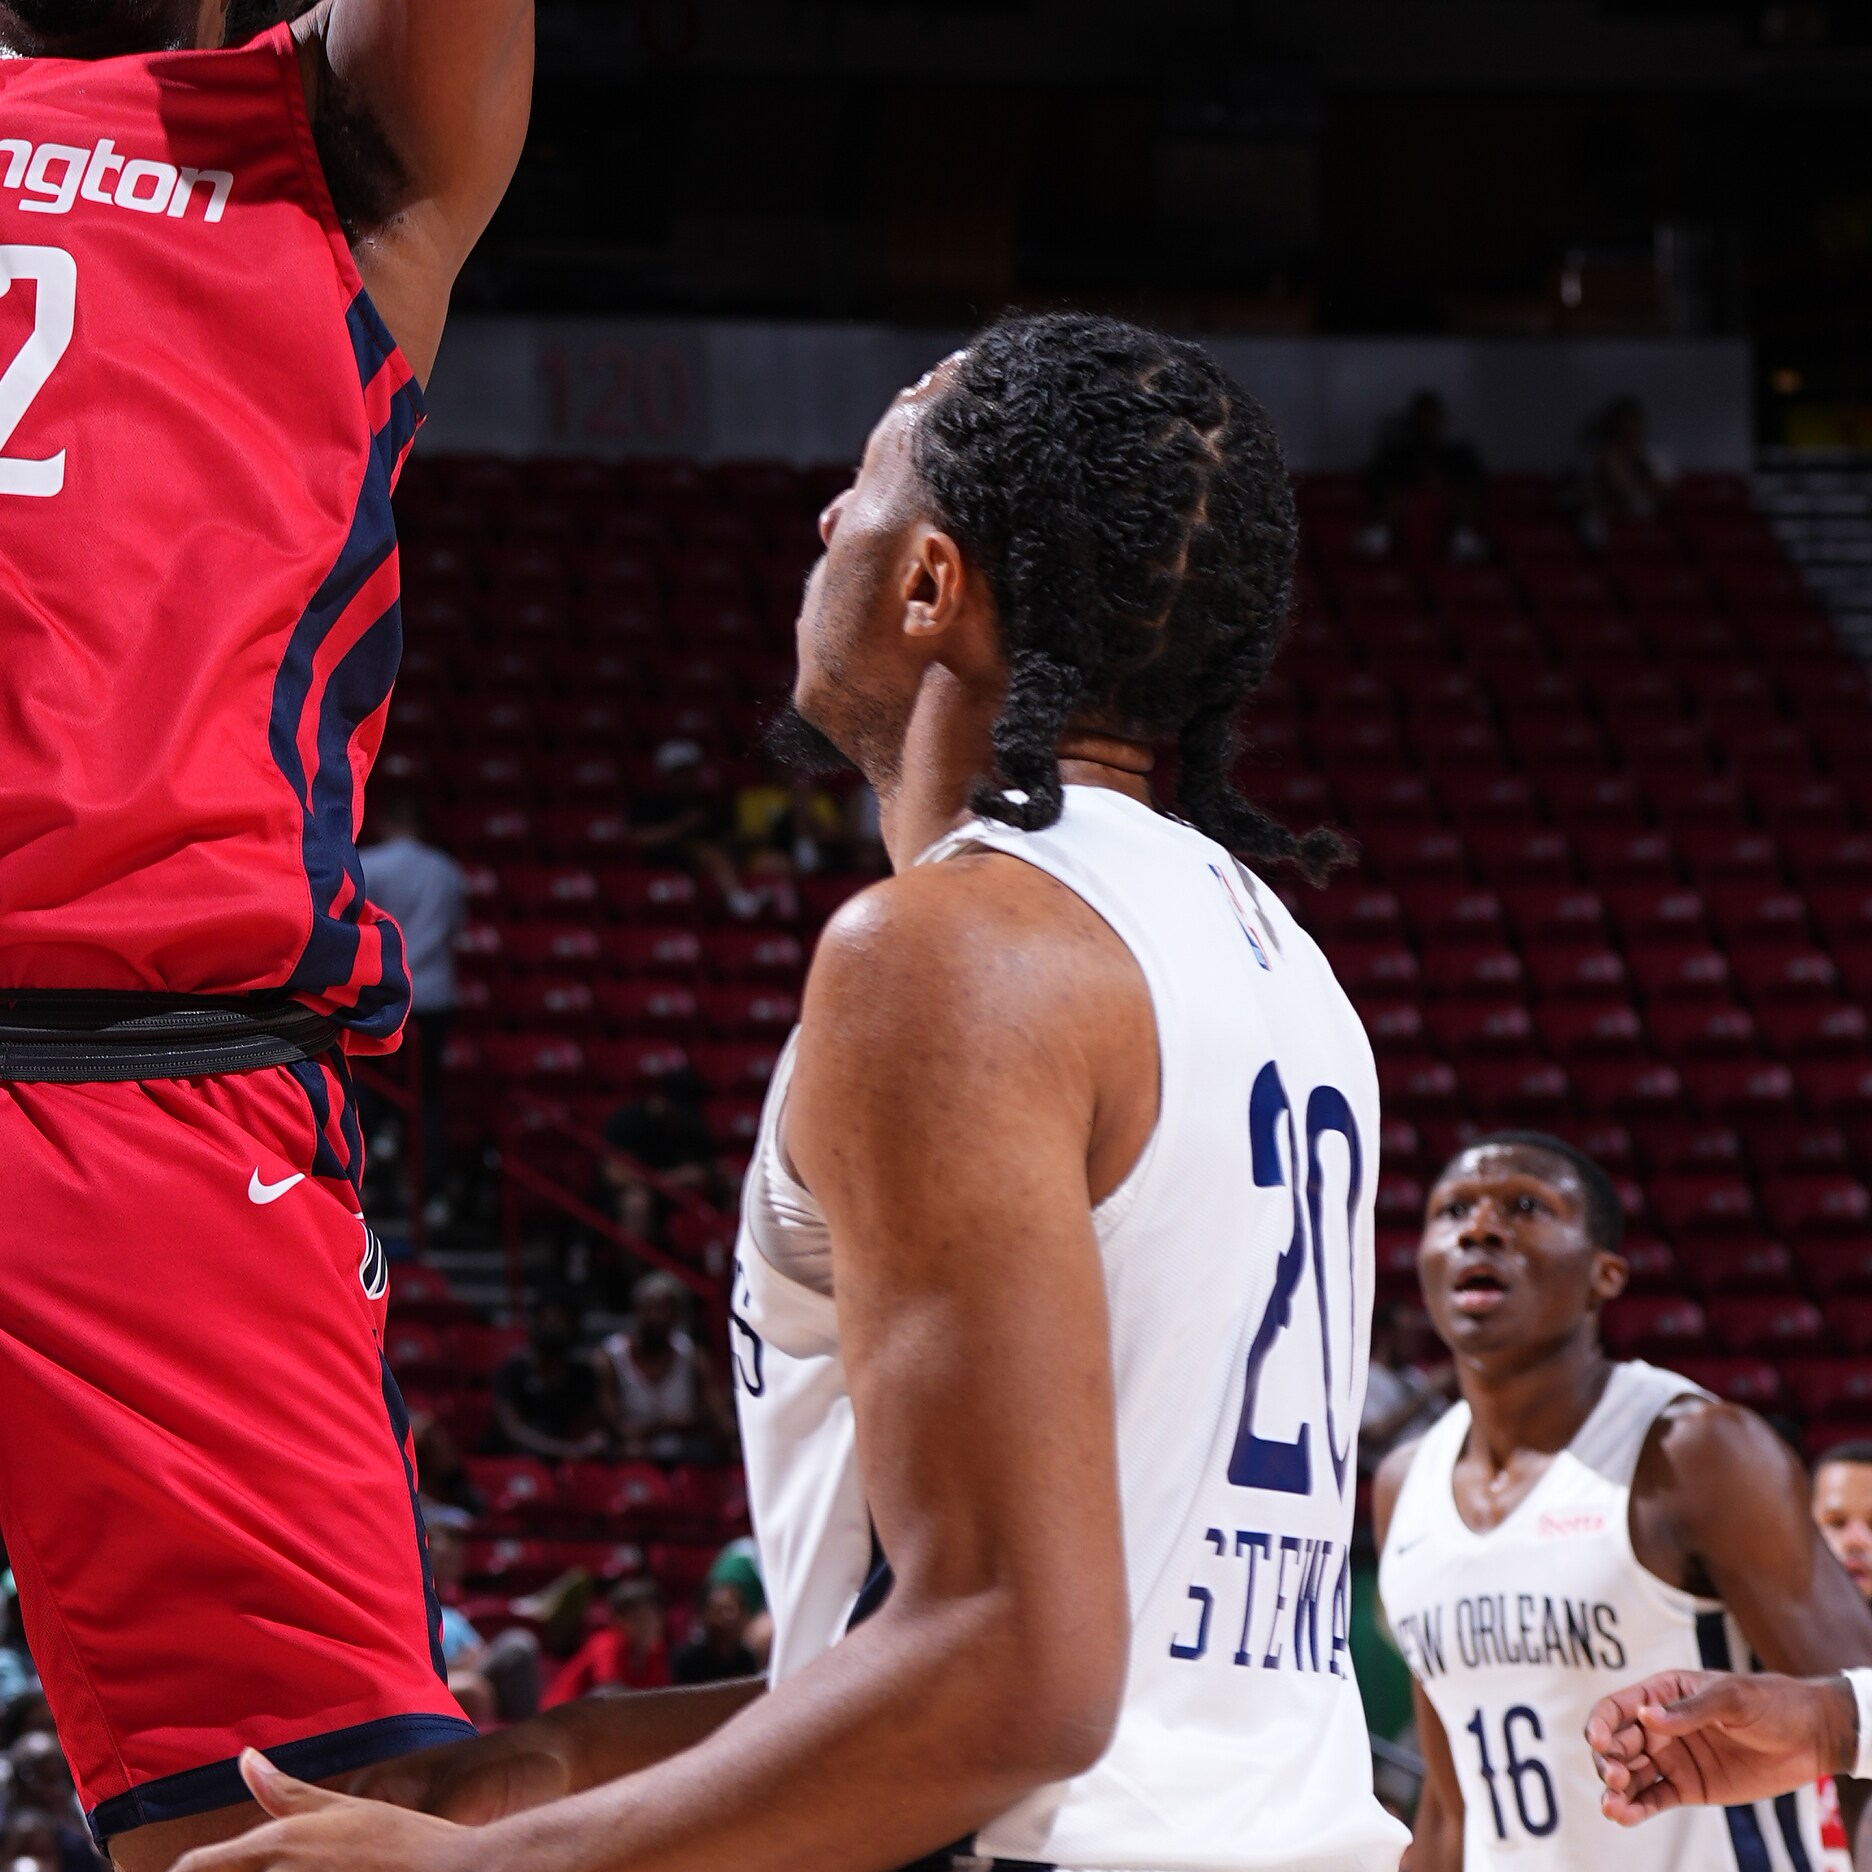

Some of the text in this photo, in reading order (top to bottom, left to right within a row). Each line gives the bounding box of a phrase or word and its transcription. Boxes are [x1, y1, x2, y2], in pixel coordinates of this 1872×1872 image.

[539, 340, 692, 441] 120
[1228, 1059, 1361, 1504] 20
[1456, 1592, 1626, 1671] ORLEANS
[1466, 1705, 1560, 1840] 16
